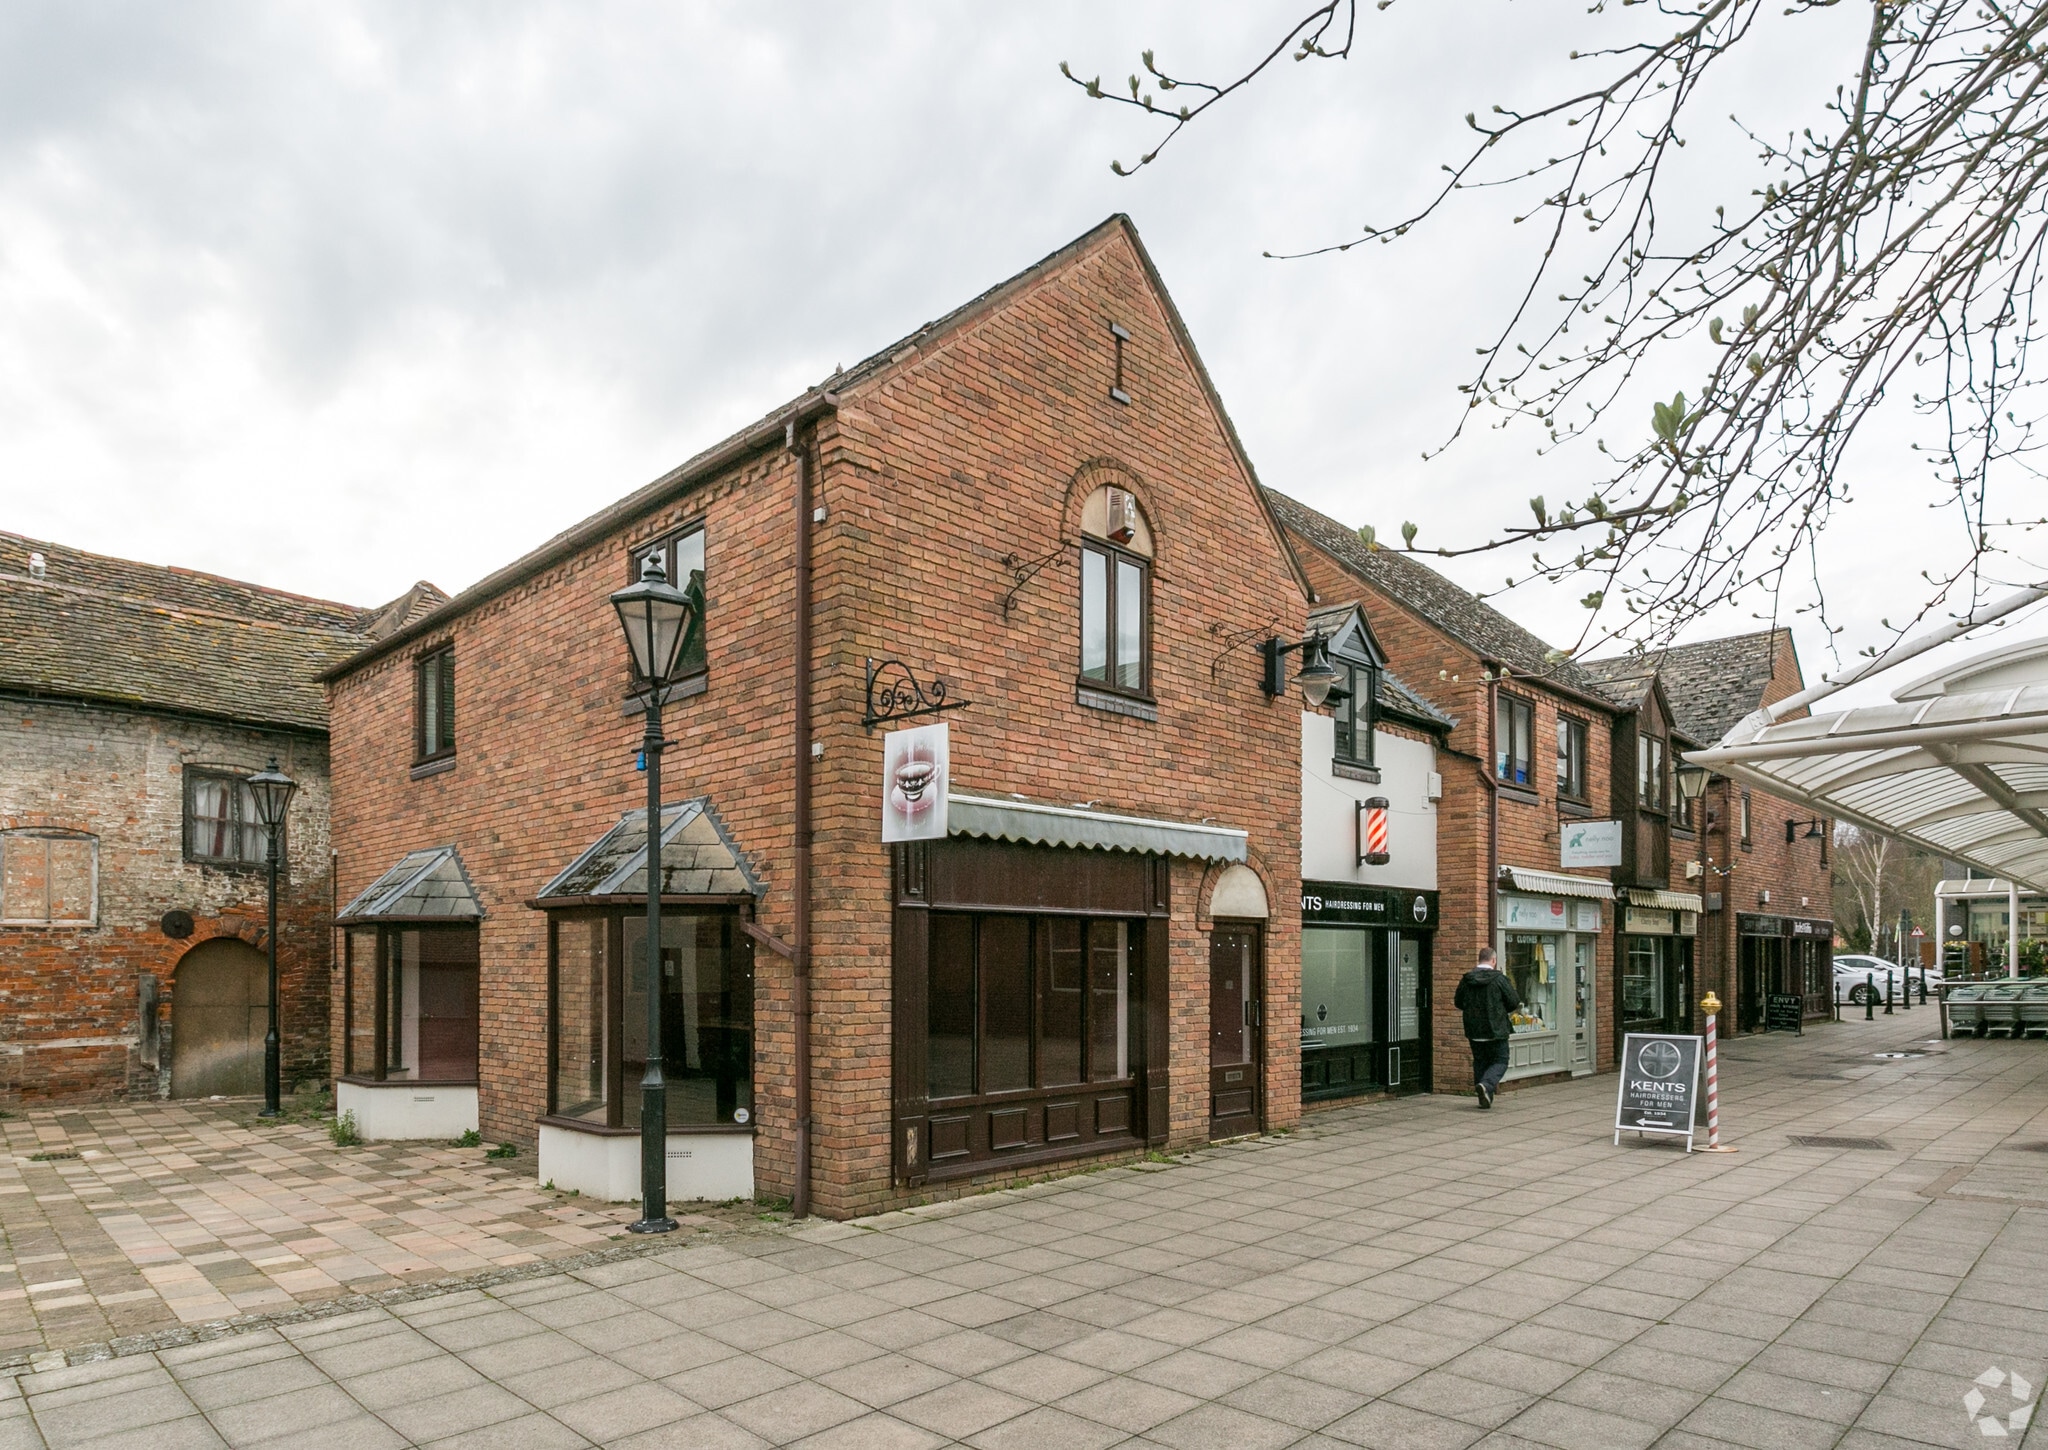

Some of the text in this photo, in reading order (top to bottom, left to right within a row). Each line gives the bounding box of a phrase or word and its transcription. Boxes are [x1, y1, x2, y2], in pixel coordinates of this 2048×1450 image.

[1325, 900, 1361, 911] HAIRDRESSING
[1362, 902, 1373, 911] FOR
[1374, 903, 1385, 911] MEN
[1773, 996, 1796, 1004] ENVY
[1317, 1027, 1327, 1036] FOR
[1327, 1026, 1337, 1035] MEN
[1630, 1080, 1686, 1093] KENTS
[1630, 1092, 1684, 1101] HAIRDRESSERS
